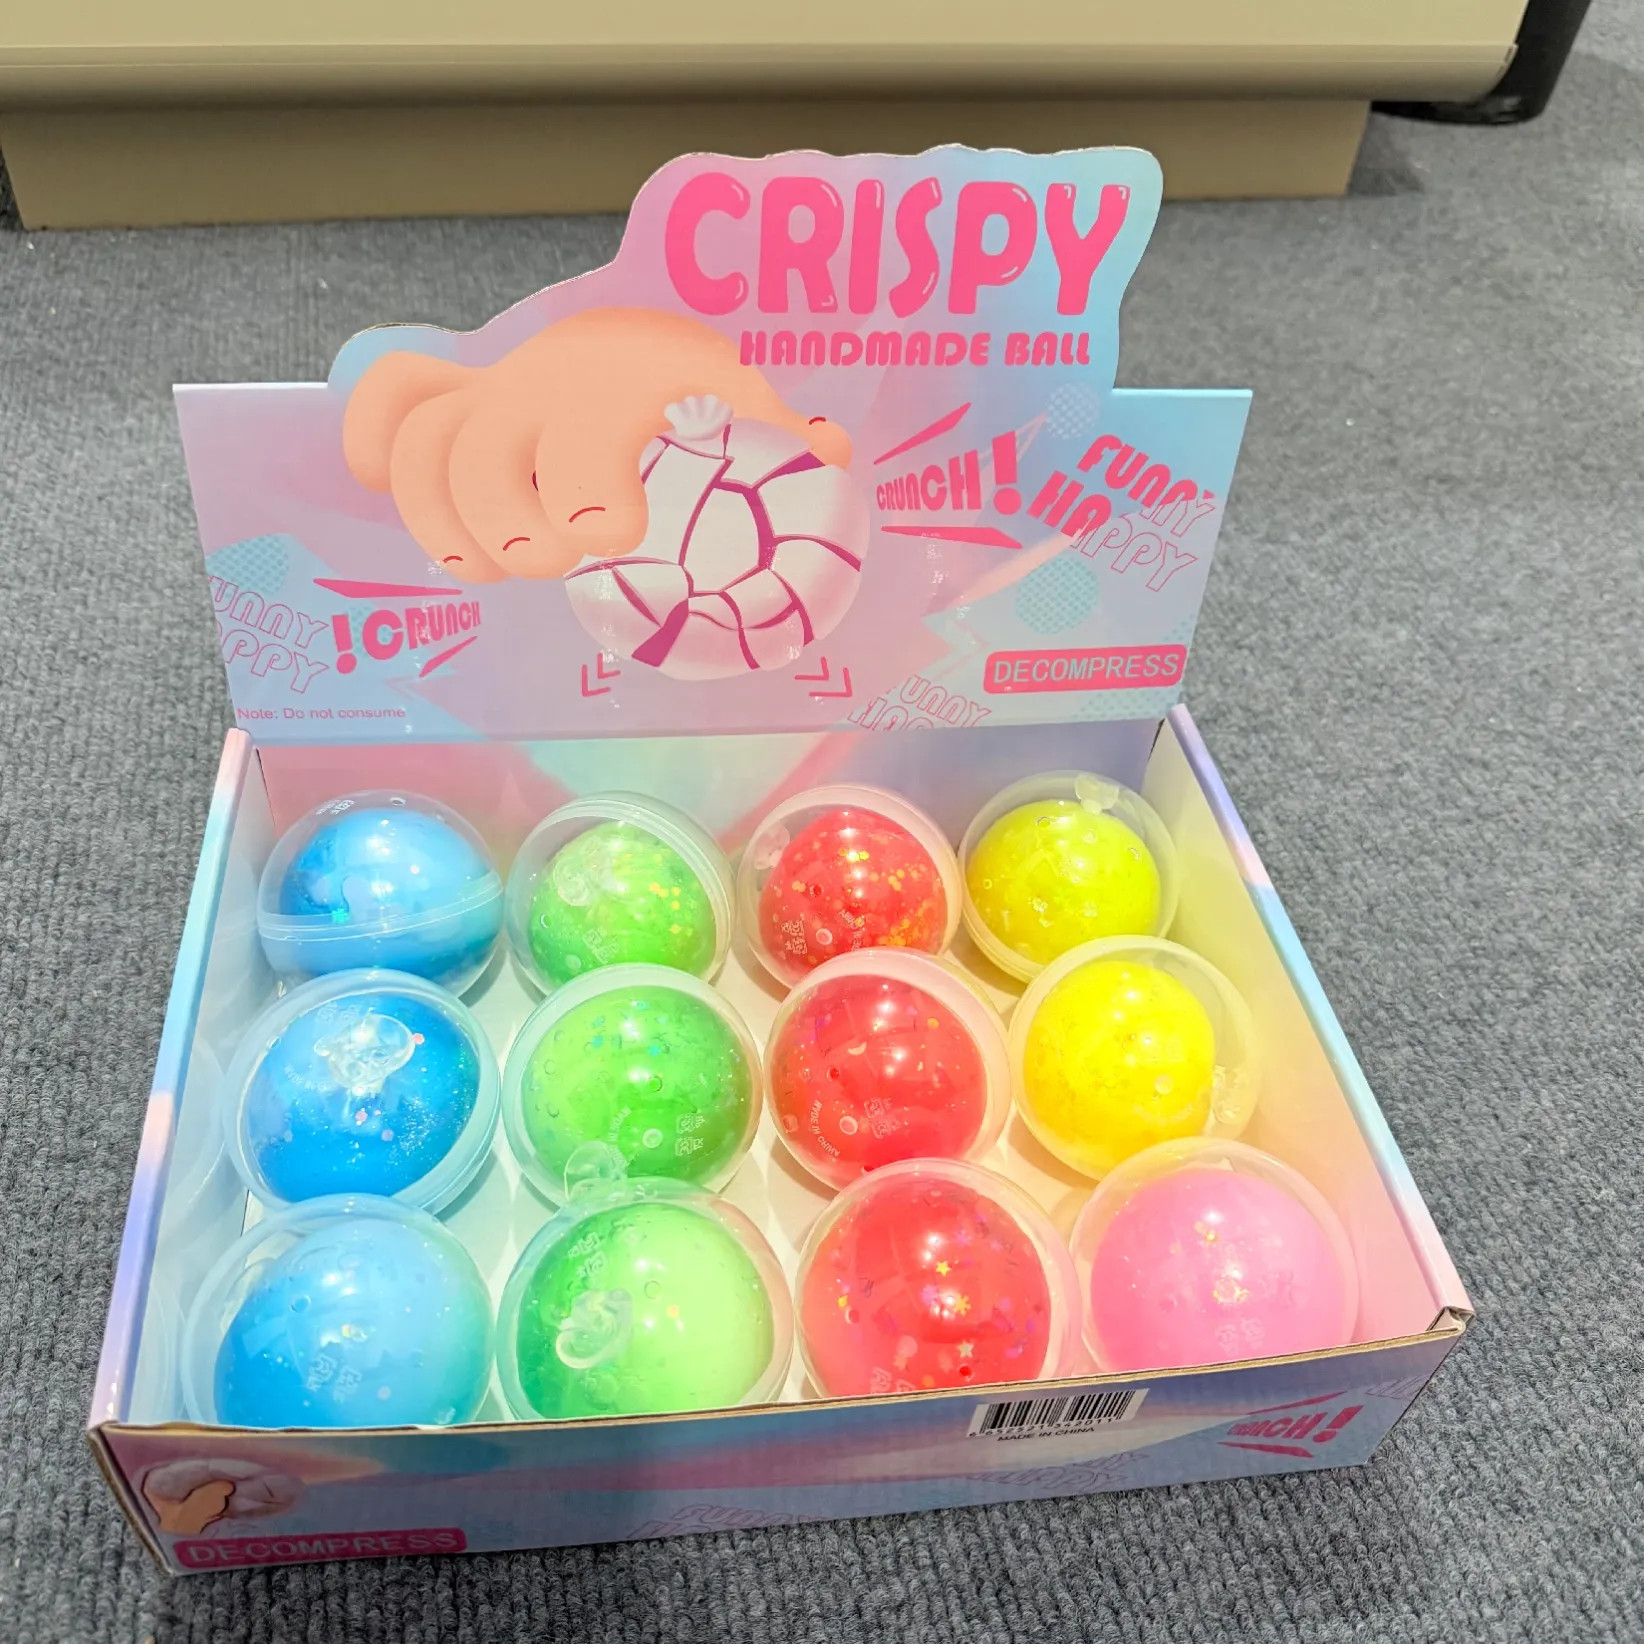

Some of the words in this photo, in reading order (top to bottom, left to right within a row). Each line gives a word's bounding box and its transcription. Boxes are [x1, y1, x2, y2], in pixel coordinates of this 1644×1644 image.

[664, 172, 1131, 318] CRISPY
[739, 330, 990, 367] HANDMADE
[1003, 331, 1091, 367] BALL
[216, 620, 330, 694] PPY
[993, 653, 1179, 684] DECOMPRESS
[237, 707, 279, 720] Note:
[283, 707, 306, 720] Do
[310, 708, 334, 720] not
[338, 709, 406, 720] consume
[997, 1432, 1036, 1442] MADE
[1055, 1427, 1095, 1437] CHINA
[189, 1533, 458, 1563] DECOMPRESS
